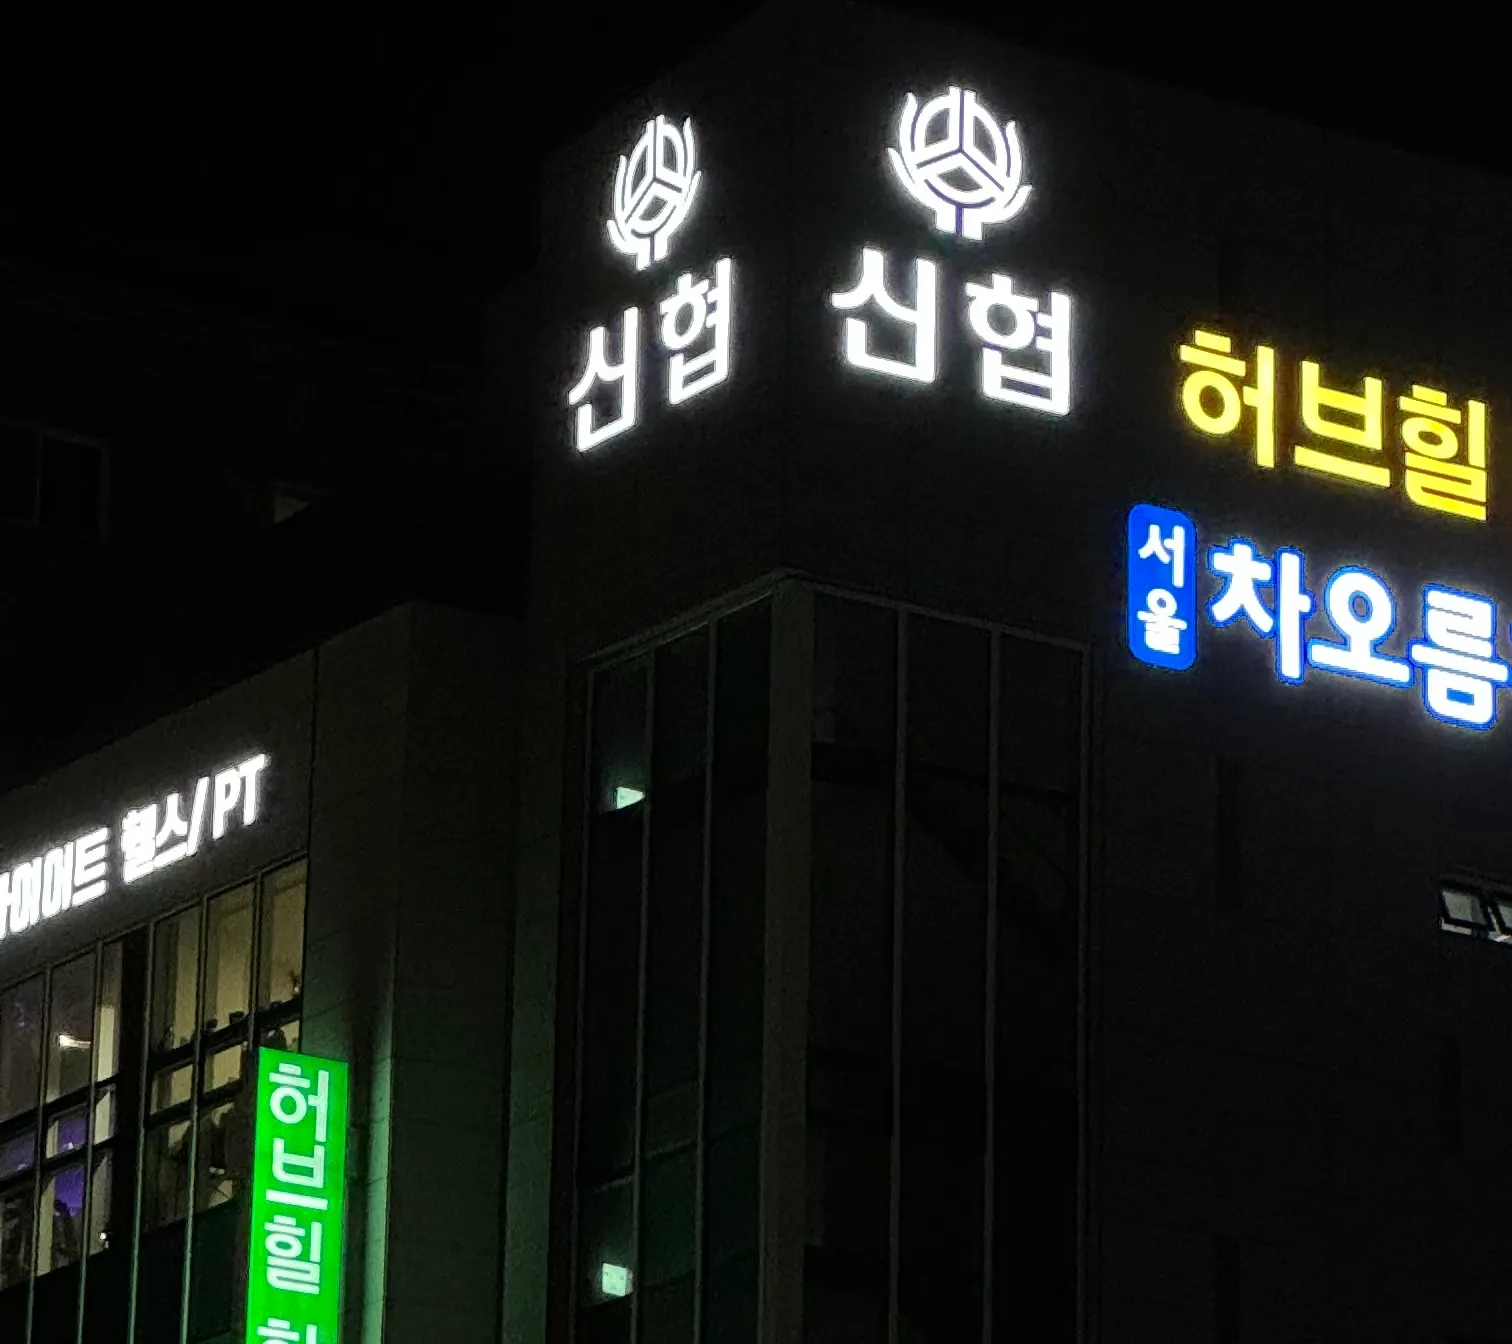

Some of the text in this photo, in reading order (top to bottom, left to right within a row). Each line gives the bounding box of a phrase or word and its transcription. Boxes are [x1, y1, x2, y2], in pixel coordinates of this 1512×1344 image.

[569, 258, 735, 452] 신협
[831, 248, 1073, 415] 신협
[1178, 330, 1489, 521] 허브힐
[1137, 525, 1187, 655] 서울
[264, 1062, 328, 1295] 허브힐
